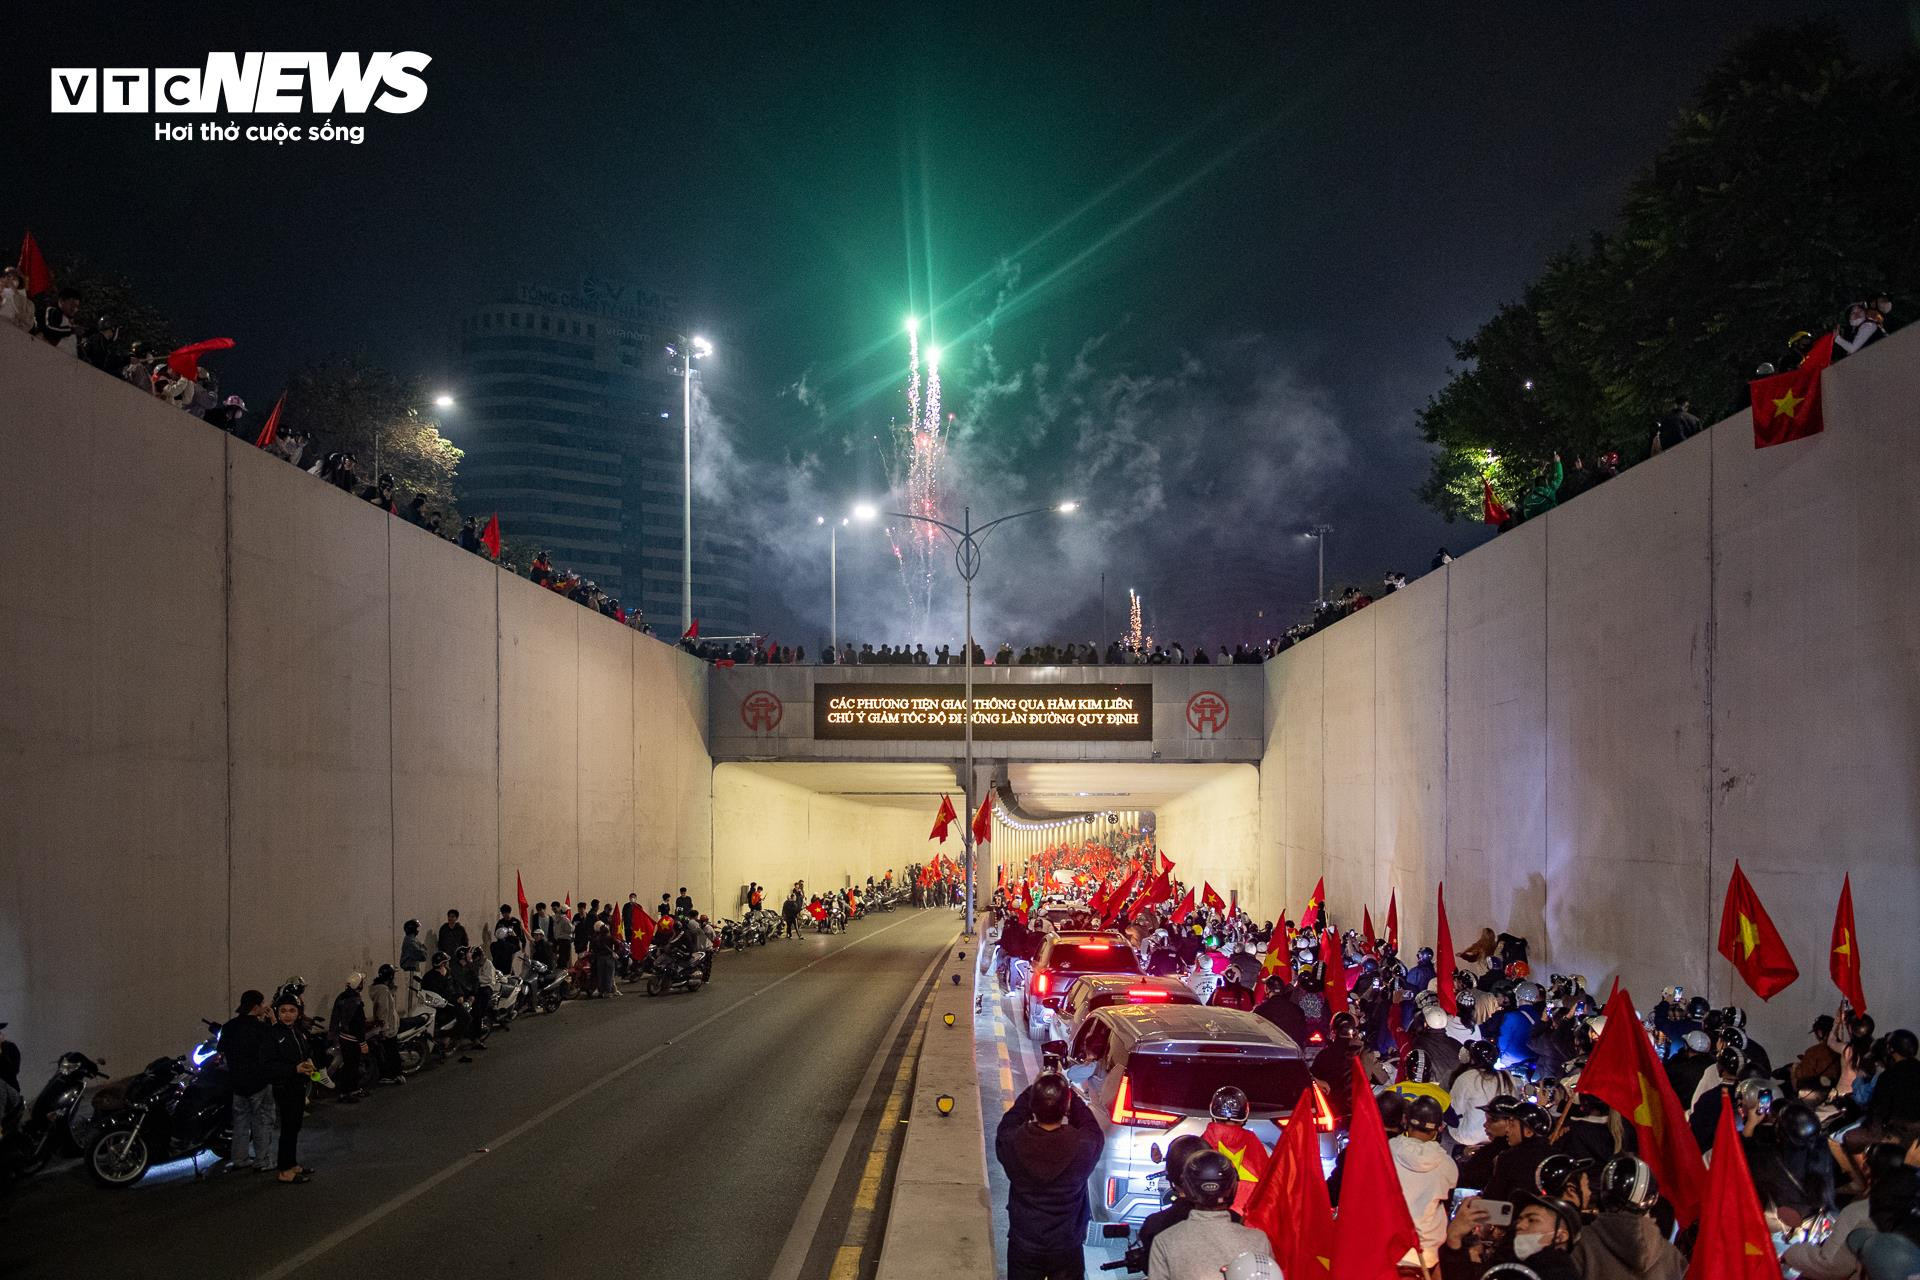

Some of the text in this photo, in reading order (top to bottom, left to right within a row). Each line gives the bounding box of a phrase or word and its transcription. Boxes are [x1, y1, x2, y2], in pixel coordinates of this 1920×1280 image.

[829, 696, 855, 710] CÁC
[856, 697, 910, 710] PHƯƠNG
[910, 697, 940, 711] TIỆN
[972, 696, 1017, 710] THÔNG
[1018, 698, 1046, 712] QUA
[1077, 698, 1103, 710] KIM
[1103, 696, 1133, 710] LIÊN
[827, 710, 854, 723] CHÚ
[855, 710, 867, 723] Ý
[927, 711, 947, 725] ĐỘ
[947, 712, 963, 724] ĐI
[1029, 711, 1076, 724] ĐƯỜNG
[1076, 713, 1105, 726] QUY
[1106, 713, 1139, 725] ĐỊNH
